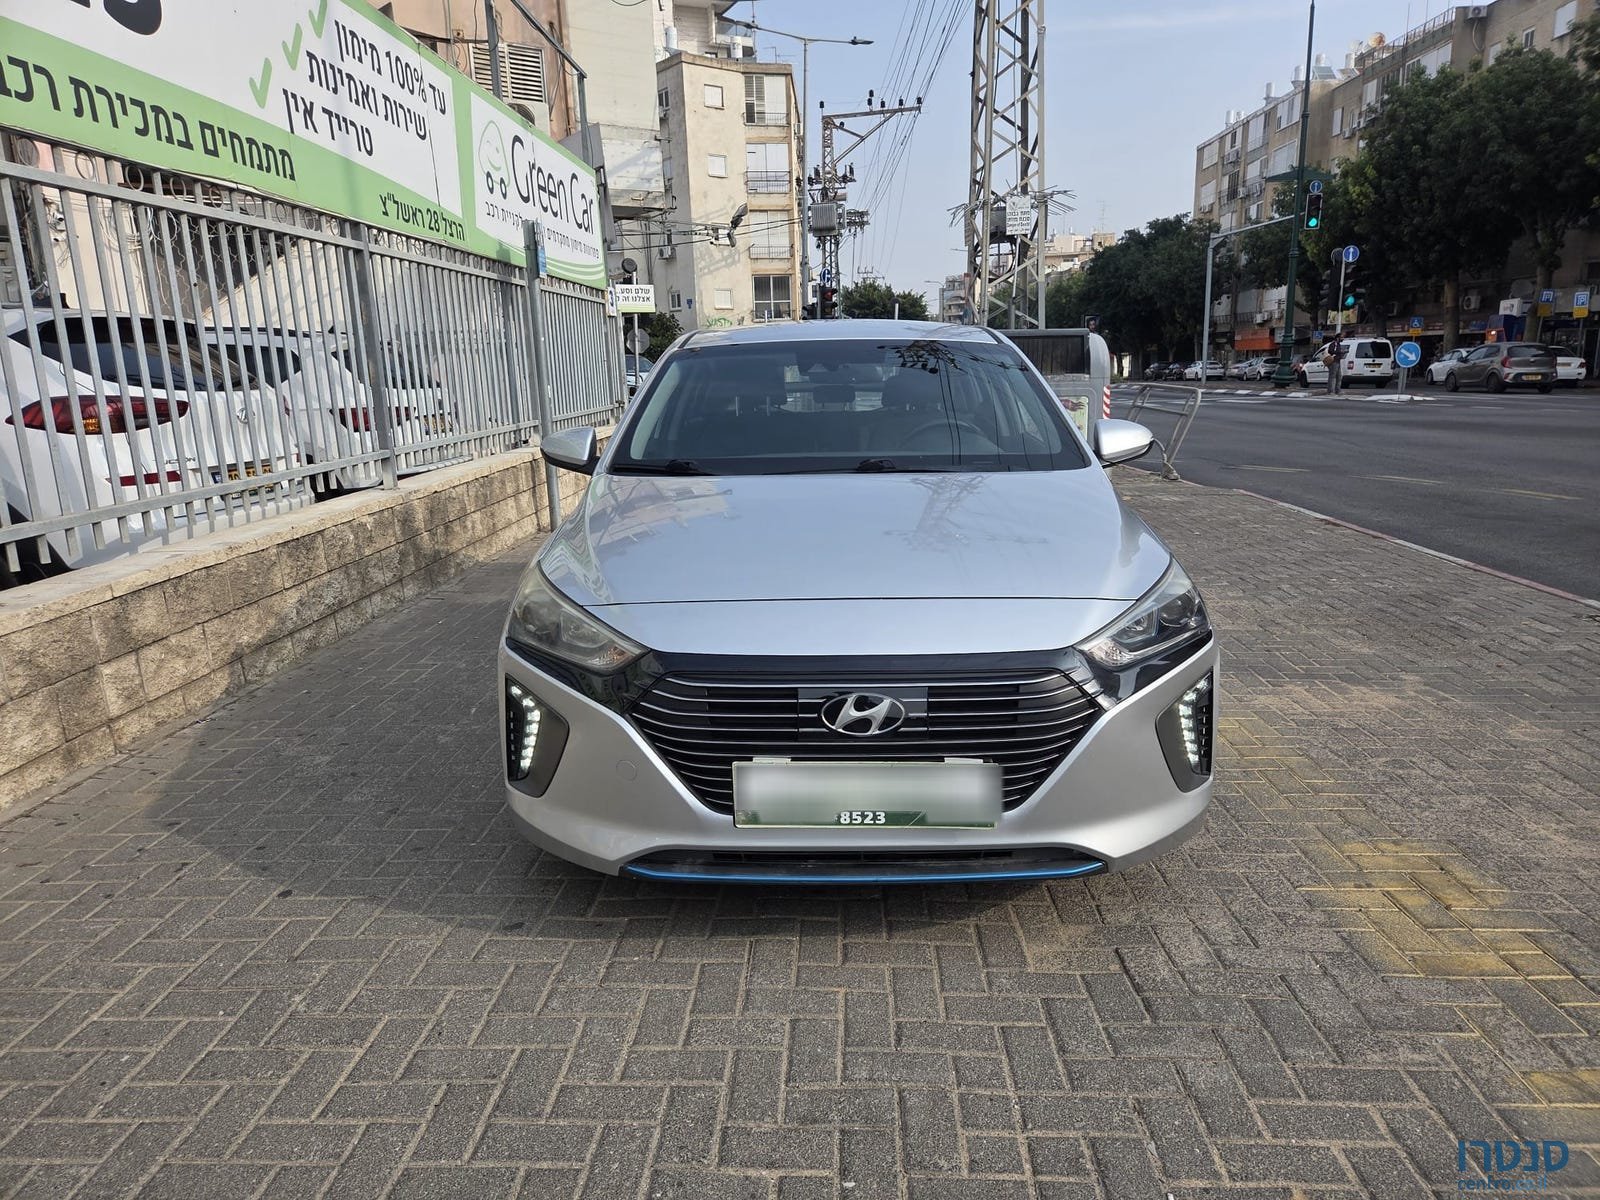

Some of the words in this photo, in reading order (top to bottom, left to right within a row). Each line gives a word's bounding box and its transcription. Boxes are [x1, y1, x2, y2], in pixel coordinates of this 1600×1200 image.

[334, 19, 382, 76] מימון
[306, 50, 379, 117] ואמינות
[385, 51, 427, 103] 100%
[429, 83, 446, 115] עד
[68, 75, 194, 151] במכירת
[282, 88, 319, 135] אין
[321, 106, 373, 157] טרייד
[382, 93, 427, 141] שירות
[198, 120, 296, 181] מתמחים
[485, 201, 499, 219] רכב
[511, 134, 569, 223] Green
[570, 172, 594, 235] Car
[426, 207, 440, 233] 28
[441, 212, 465, 241] הרצל
